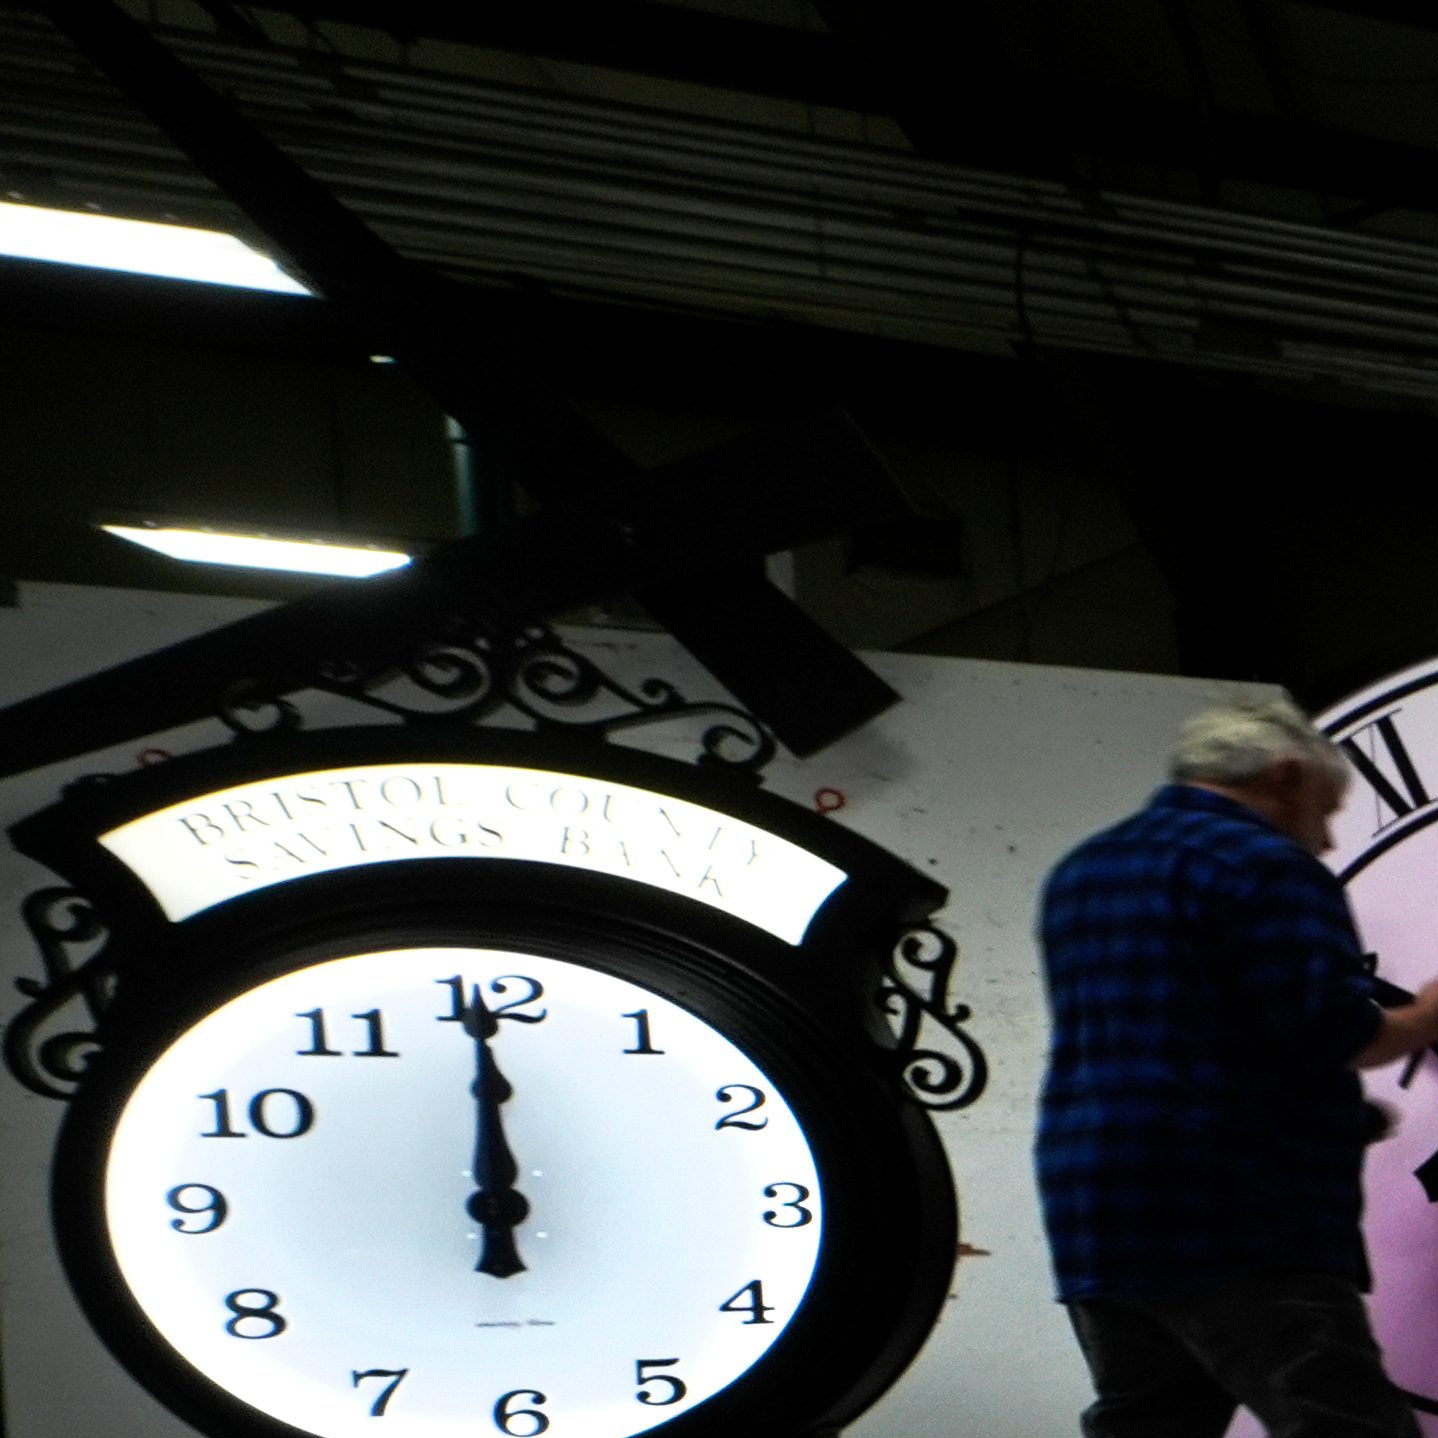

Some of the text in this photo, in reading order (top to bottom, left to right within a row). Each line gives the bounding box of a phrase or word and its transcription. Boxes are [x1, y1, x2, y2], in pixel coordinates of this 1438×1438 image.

[177, 776, 765, 867] BRISTOL COUNTY
[223, 816, 727, 898] SAVINGS BANK
[434, 974, 547, 1023] 12
[298, 1009, 398, 1057] 11
[623, 1009, 665, 1055] 1
[201, 1089, 314, 1139] 10
[716, 1084, 768, 1131] 2
[168, 1184, 228, 1234] 9
[763, 1183, 813, 1228] 3
[225, 1289, 287, 1340] 8
[719, 1280, 775, 1325] 4
[352, 1369, 408, 1417] 7
[636, 1358, 687, 1406] 5
[493, 1389, 550, 1437] 6
